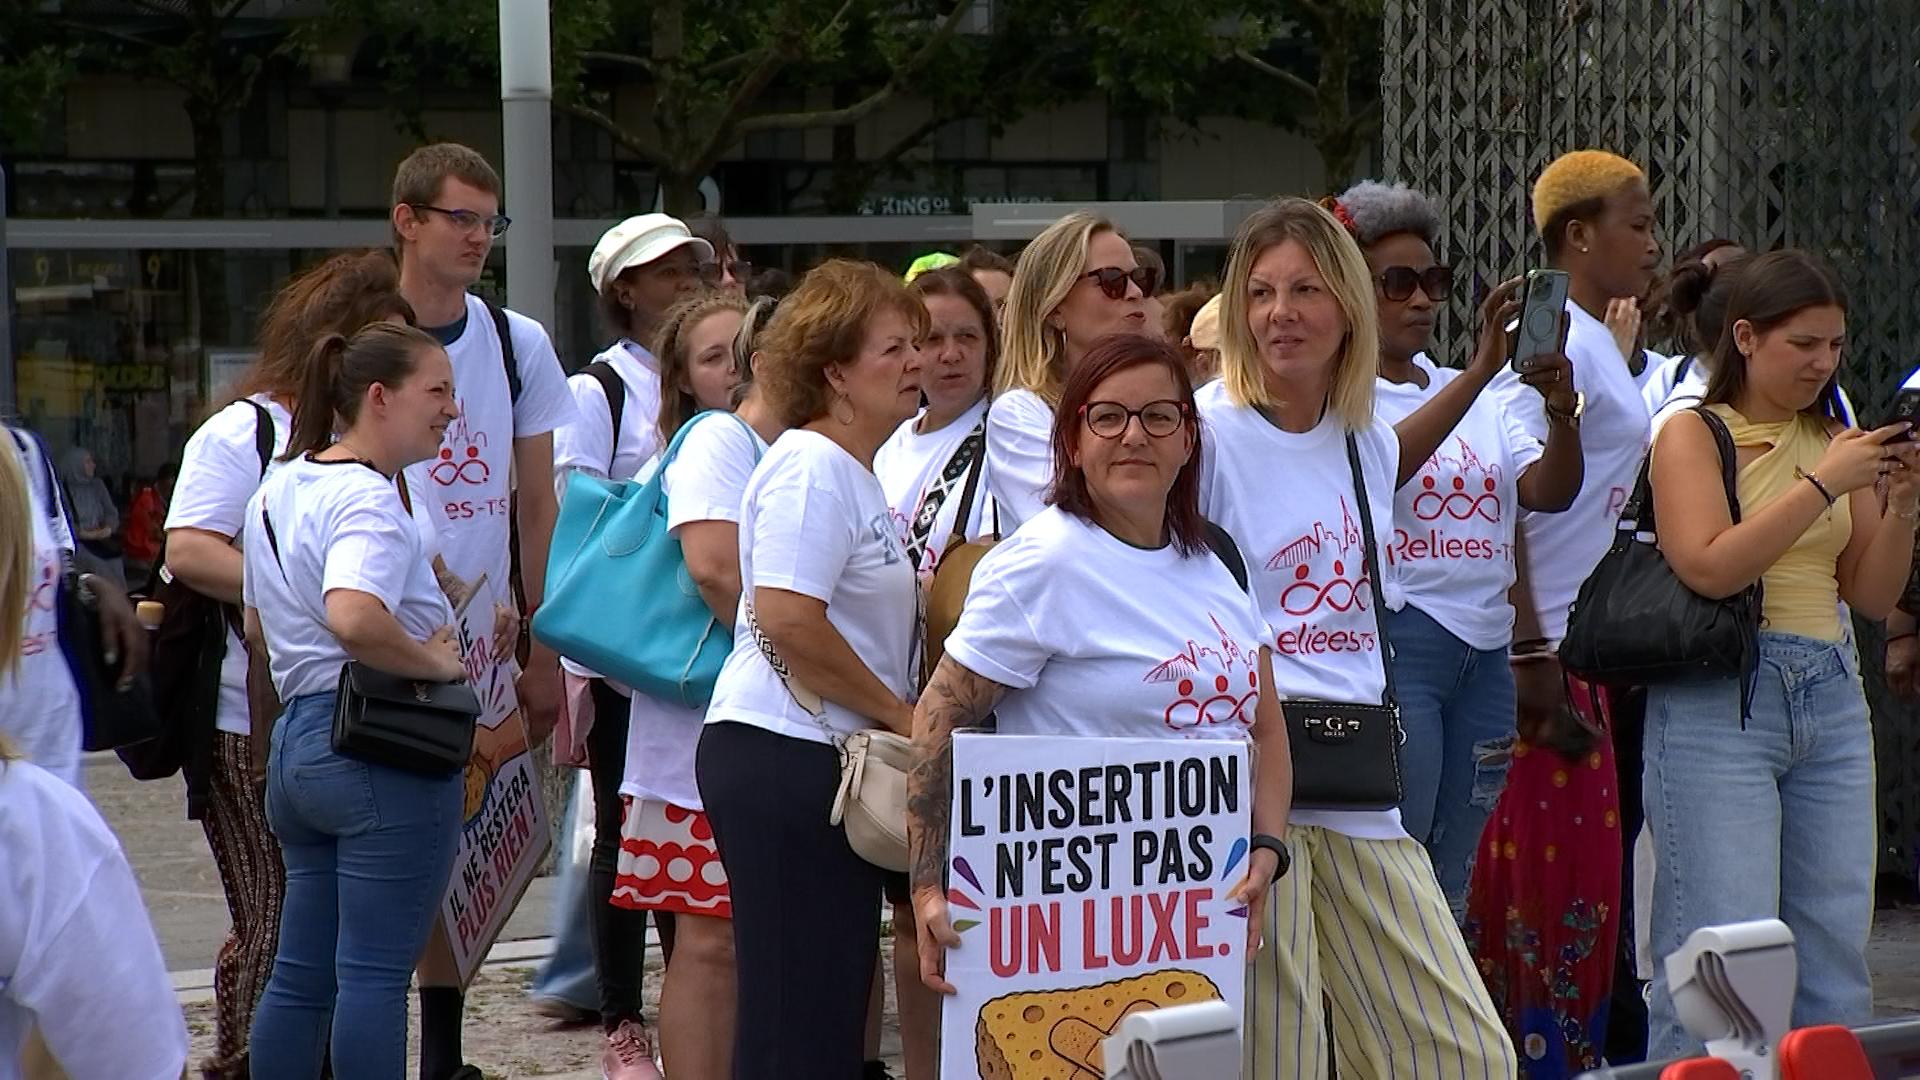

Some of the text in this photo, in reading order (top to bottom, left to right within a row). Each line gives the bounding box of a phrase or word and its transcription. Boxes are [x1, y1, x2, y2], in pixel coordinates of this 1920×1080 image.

[445, 498, 507, 520] es-TS
[1386, 529, 1514, 566] Reliees-T
[960, 754, 1239, 837] L'INSERTION
[449, 888, 465, 922] IL
[462, 851, 482, 896] NE
[480, 763, 531, 864] RESTERA
[457, 871, 496, 958] PLUS
[493, 803, 531, 888] RIEN
[996, 825, 1213, 899] N'EST PAS
[989, 888, 1231, 978] UN LUXE.
